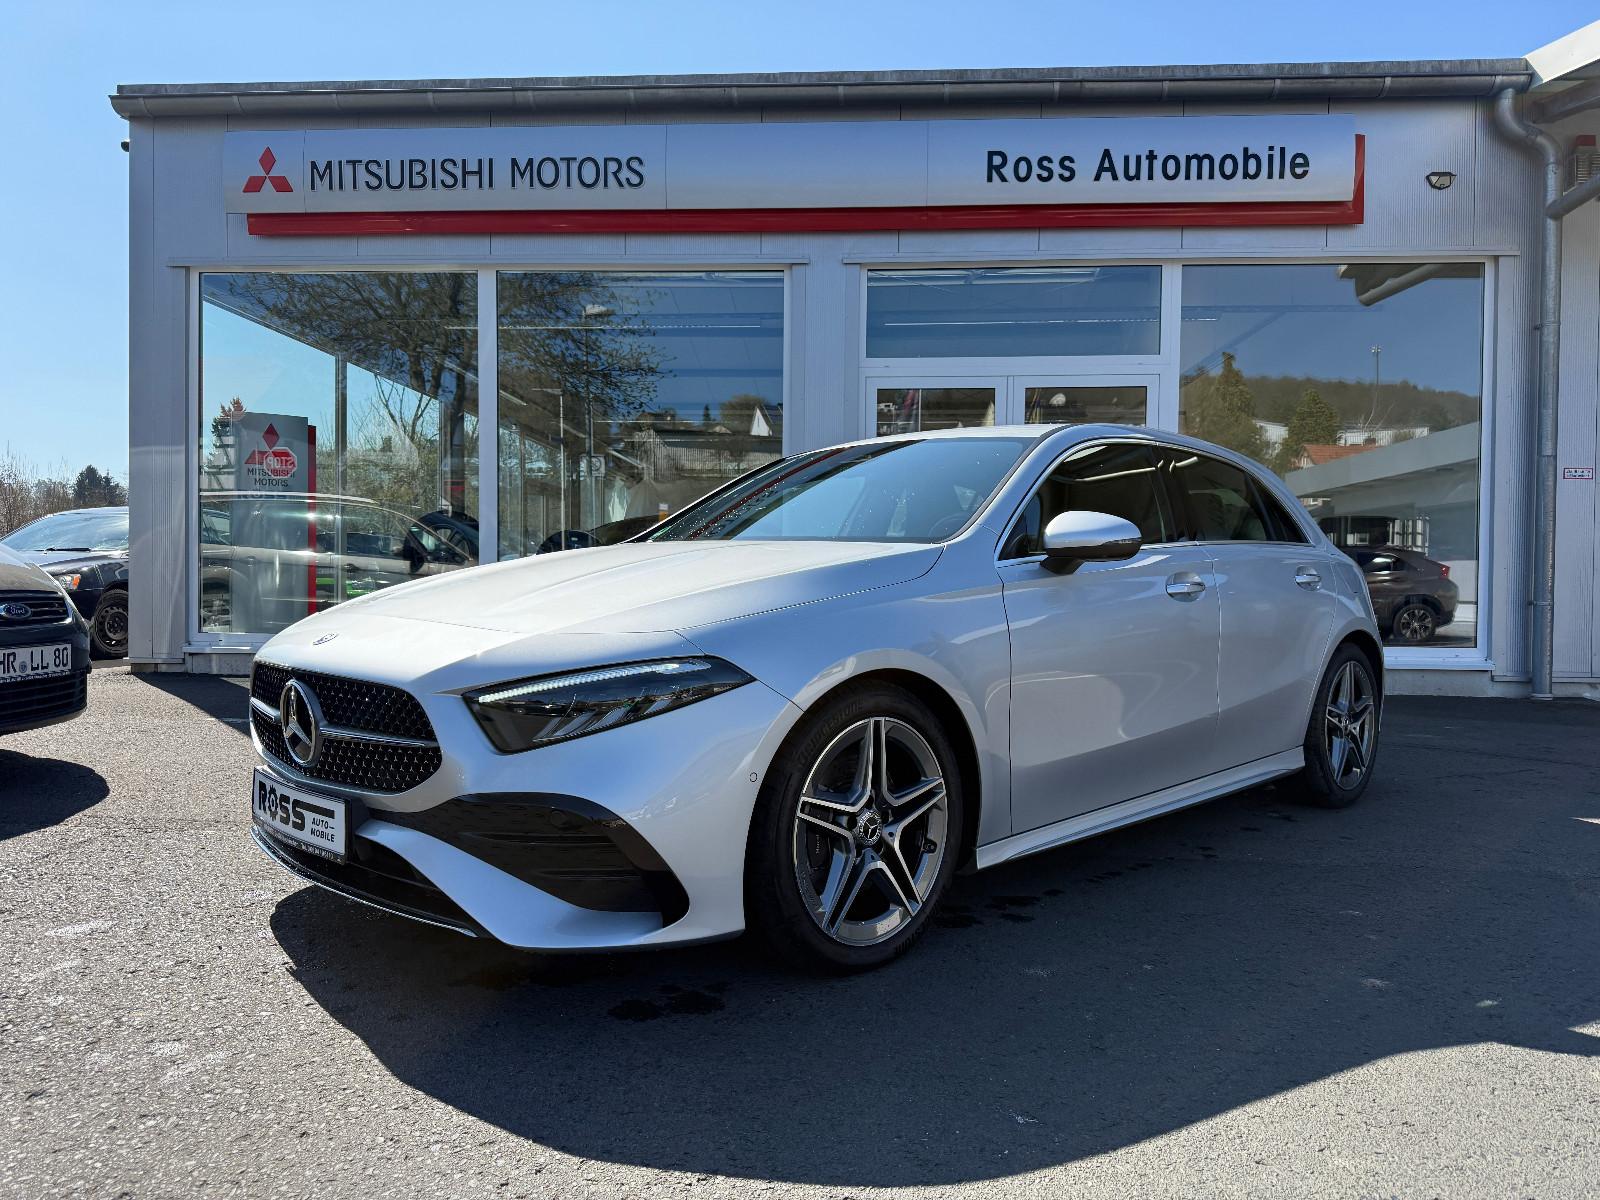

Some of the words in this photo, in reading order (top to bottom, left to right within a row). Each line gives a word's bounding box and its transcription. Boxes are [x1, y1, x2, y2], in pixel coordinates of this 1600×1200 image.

[310, 157, 494, 191] MITSUBISHI
[510, 156, 646, 189] MOTORS
[986, 150, 1076, 182] Ross
[1093, 145, 1310, 181] Automobile
[255, 479, 288, 487] MOTORS
[30, 649, 49, 671] LL
[53, 646, 69, 668] 80
[258, 780, 312, 831] ROSS
[310, 827, 335, 842] MOBILE
